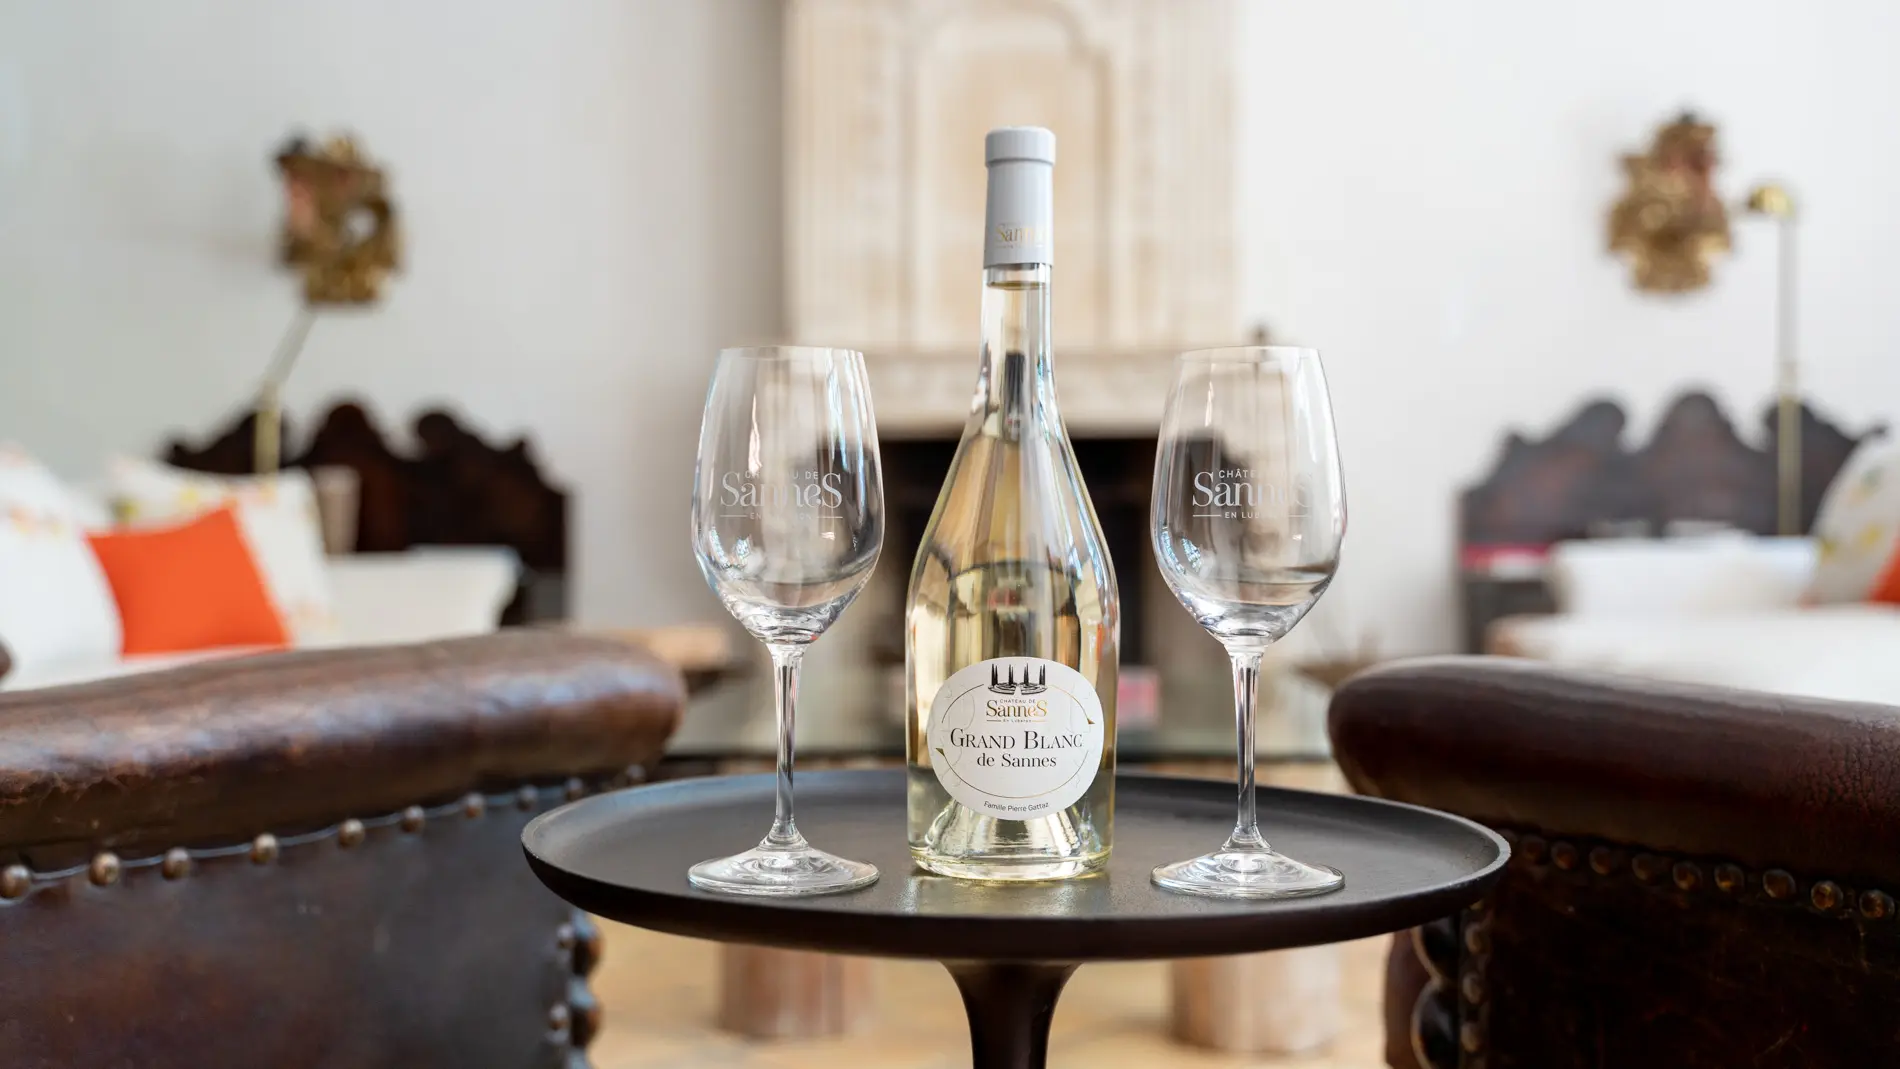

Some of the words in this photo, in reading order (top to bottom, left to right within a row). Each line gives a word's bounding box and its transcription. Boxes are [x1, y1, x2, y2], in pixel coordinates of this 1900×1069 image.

[749, 512, 762, 520] EN
[1224, 511, 1237, 519] EN
[976, 752, 995, 767] de
[1001, 753, 1058, 768] Sannes
[983, 800, 1007, 812] Famille
[1007, 804, 1028, 812] Pierre
[1027, 802, 1050, 811] Gattaz
